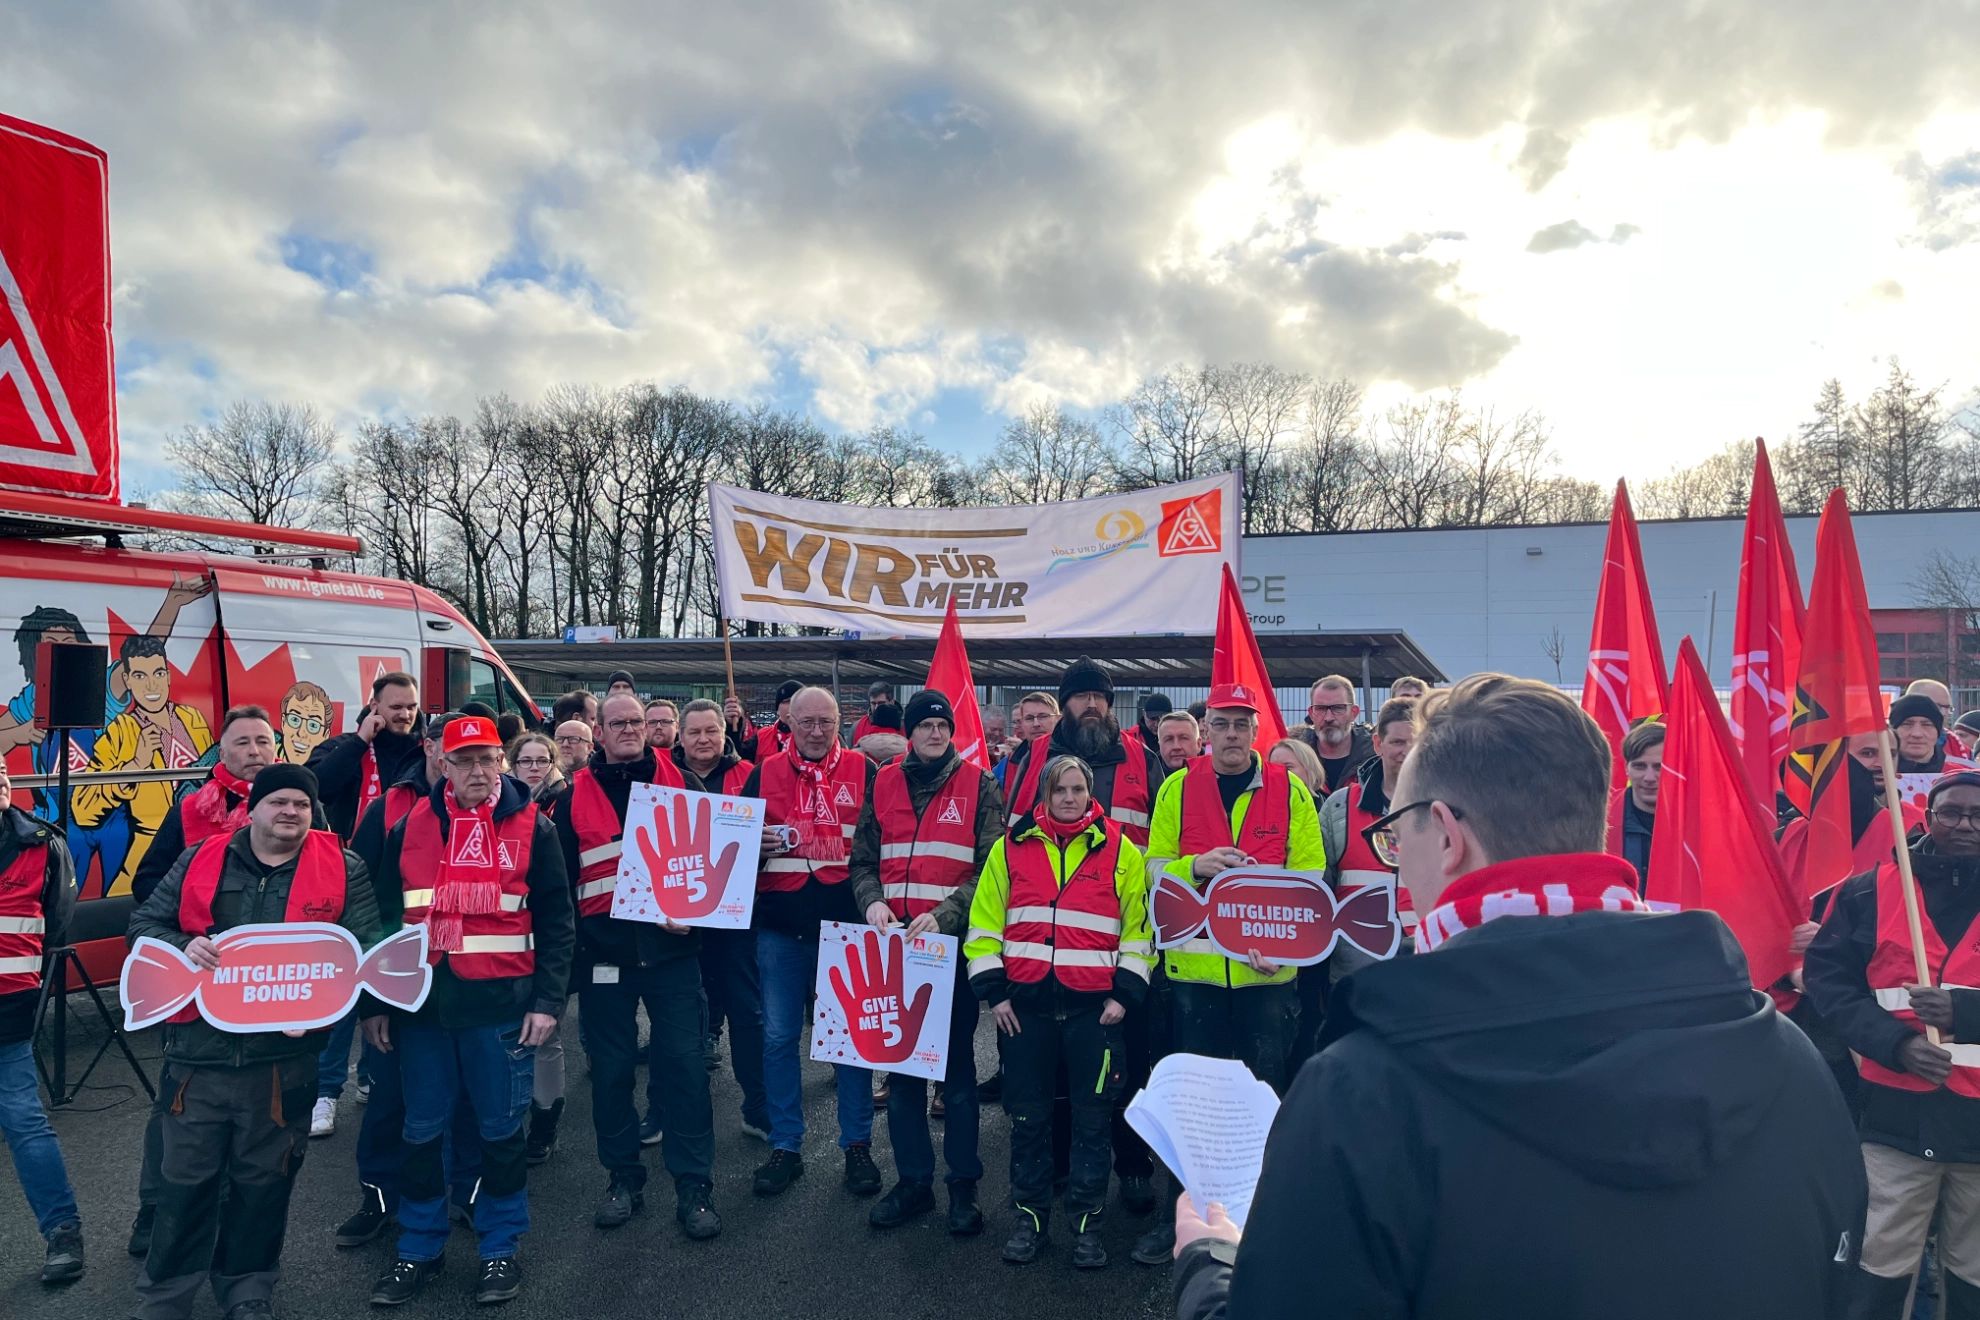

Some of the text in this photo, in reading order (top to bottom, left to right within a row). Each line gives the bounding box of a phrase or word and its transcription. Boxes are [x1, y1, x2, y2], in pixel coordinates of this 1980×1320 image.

[1077, 546, 1097, 554] UND
[733, 520, 917, 607] WIR
[915, 547, 998, 579] FÜR
[262, 576, 385, 600] www.igmetall.de
[914, 581, 1028, 609] MEHR
[667, 854, 705, 873] GIVE
[663, 869, 708, 904] ME 5
[1217, 902, 1322, 924] MITGLIEDER-
[1241, 921, 1297, 940] BONUS
[212, 962, 344, 985] MITGLIEDER-
[243, 983, 313, 1004] BONUS
[862, 995, 899, 1014] GIVE
[858, 1011, 903, 1047] ME 5
